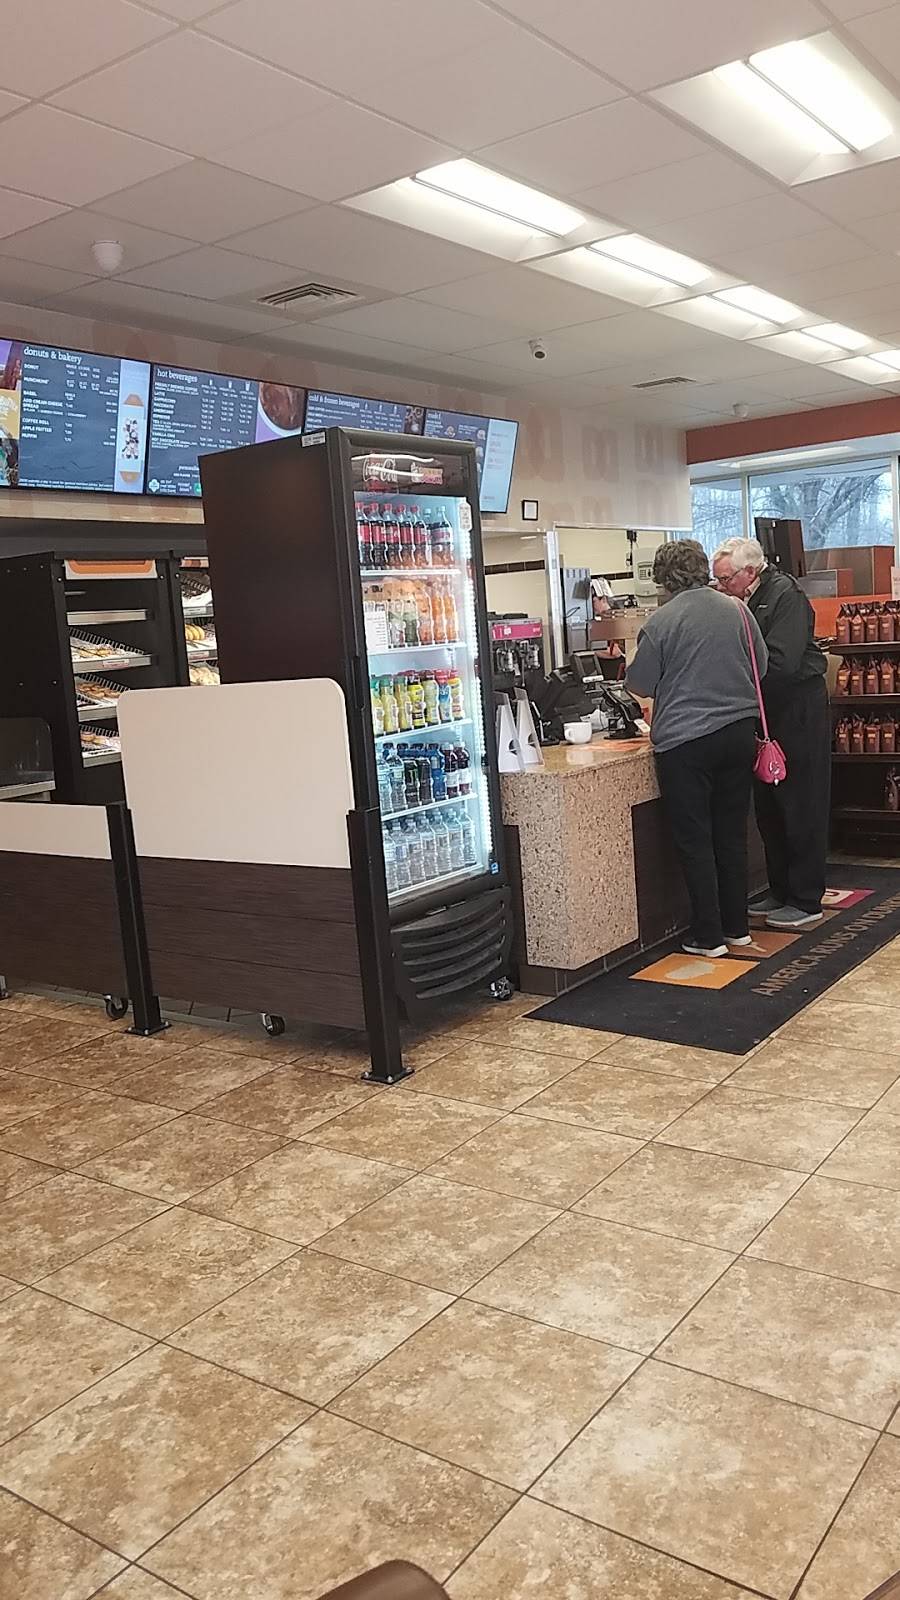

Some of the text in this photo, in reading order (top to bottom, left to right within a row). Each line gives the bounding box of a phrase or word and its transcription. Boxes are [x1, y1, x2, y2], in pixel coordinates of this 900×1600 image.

[23, 347, 82, 365] donuts & bakery
[157, 369, 198, 383] hot beverages
[751, 954, 827, 998] AMERICA
[809, 931, 859, 955] RUNS
[843, 918, 880, 931] ON
